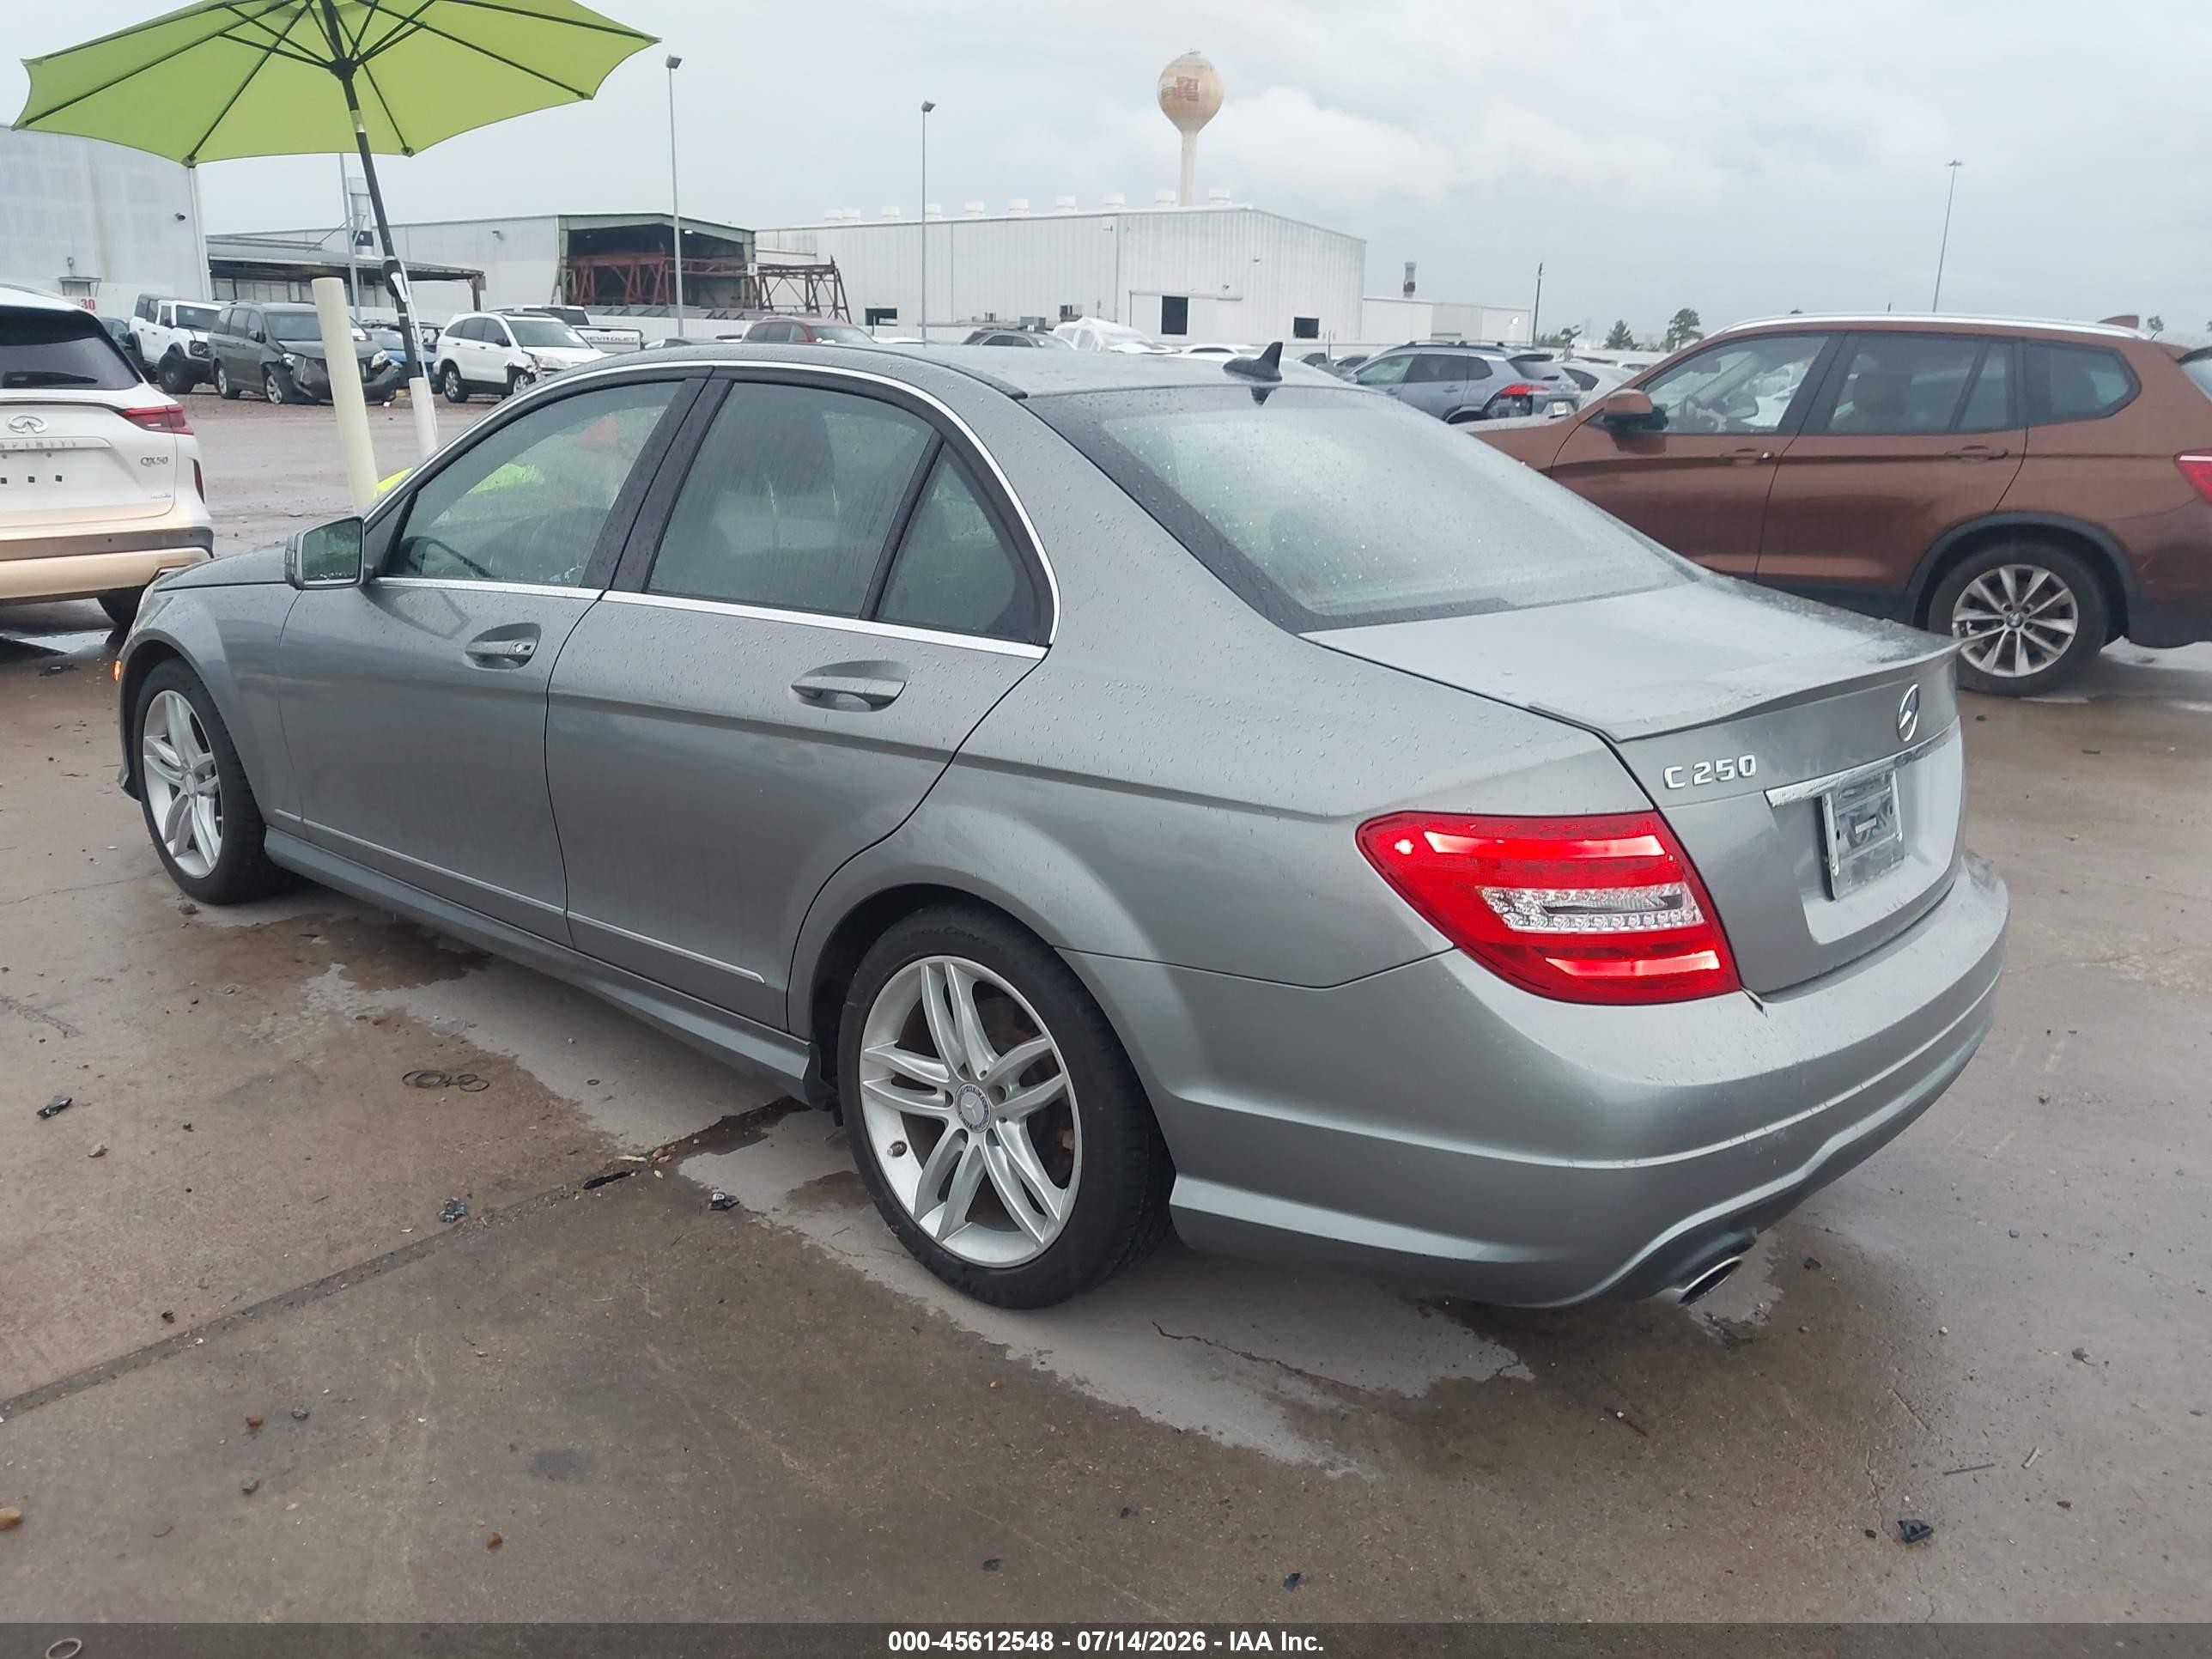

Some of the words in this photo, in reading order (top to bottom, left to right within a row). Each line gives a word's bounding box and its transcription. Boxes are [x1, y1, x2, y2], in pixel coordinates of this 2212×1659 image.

[80, 298, 96, 311] 30
[140, 456, 169, 467] QX50
[1663, 765, 1686, 789] C
[1692, 754, 1757, 786] 250
